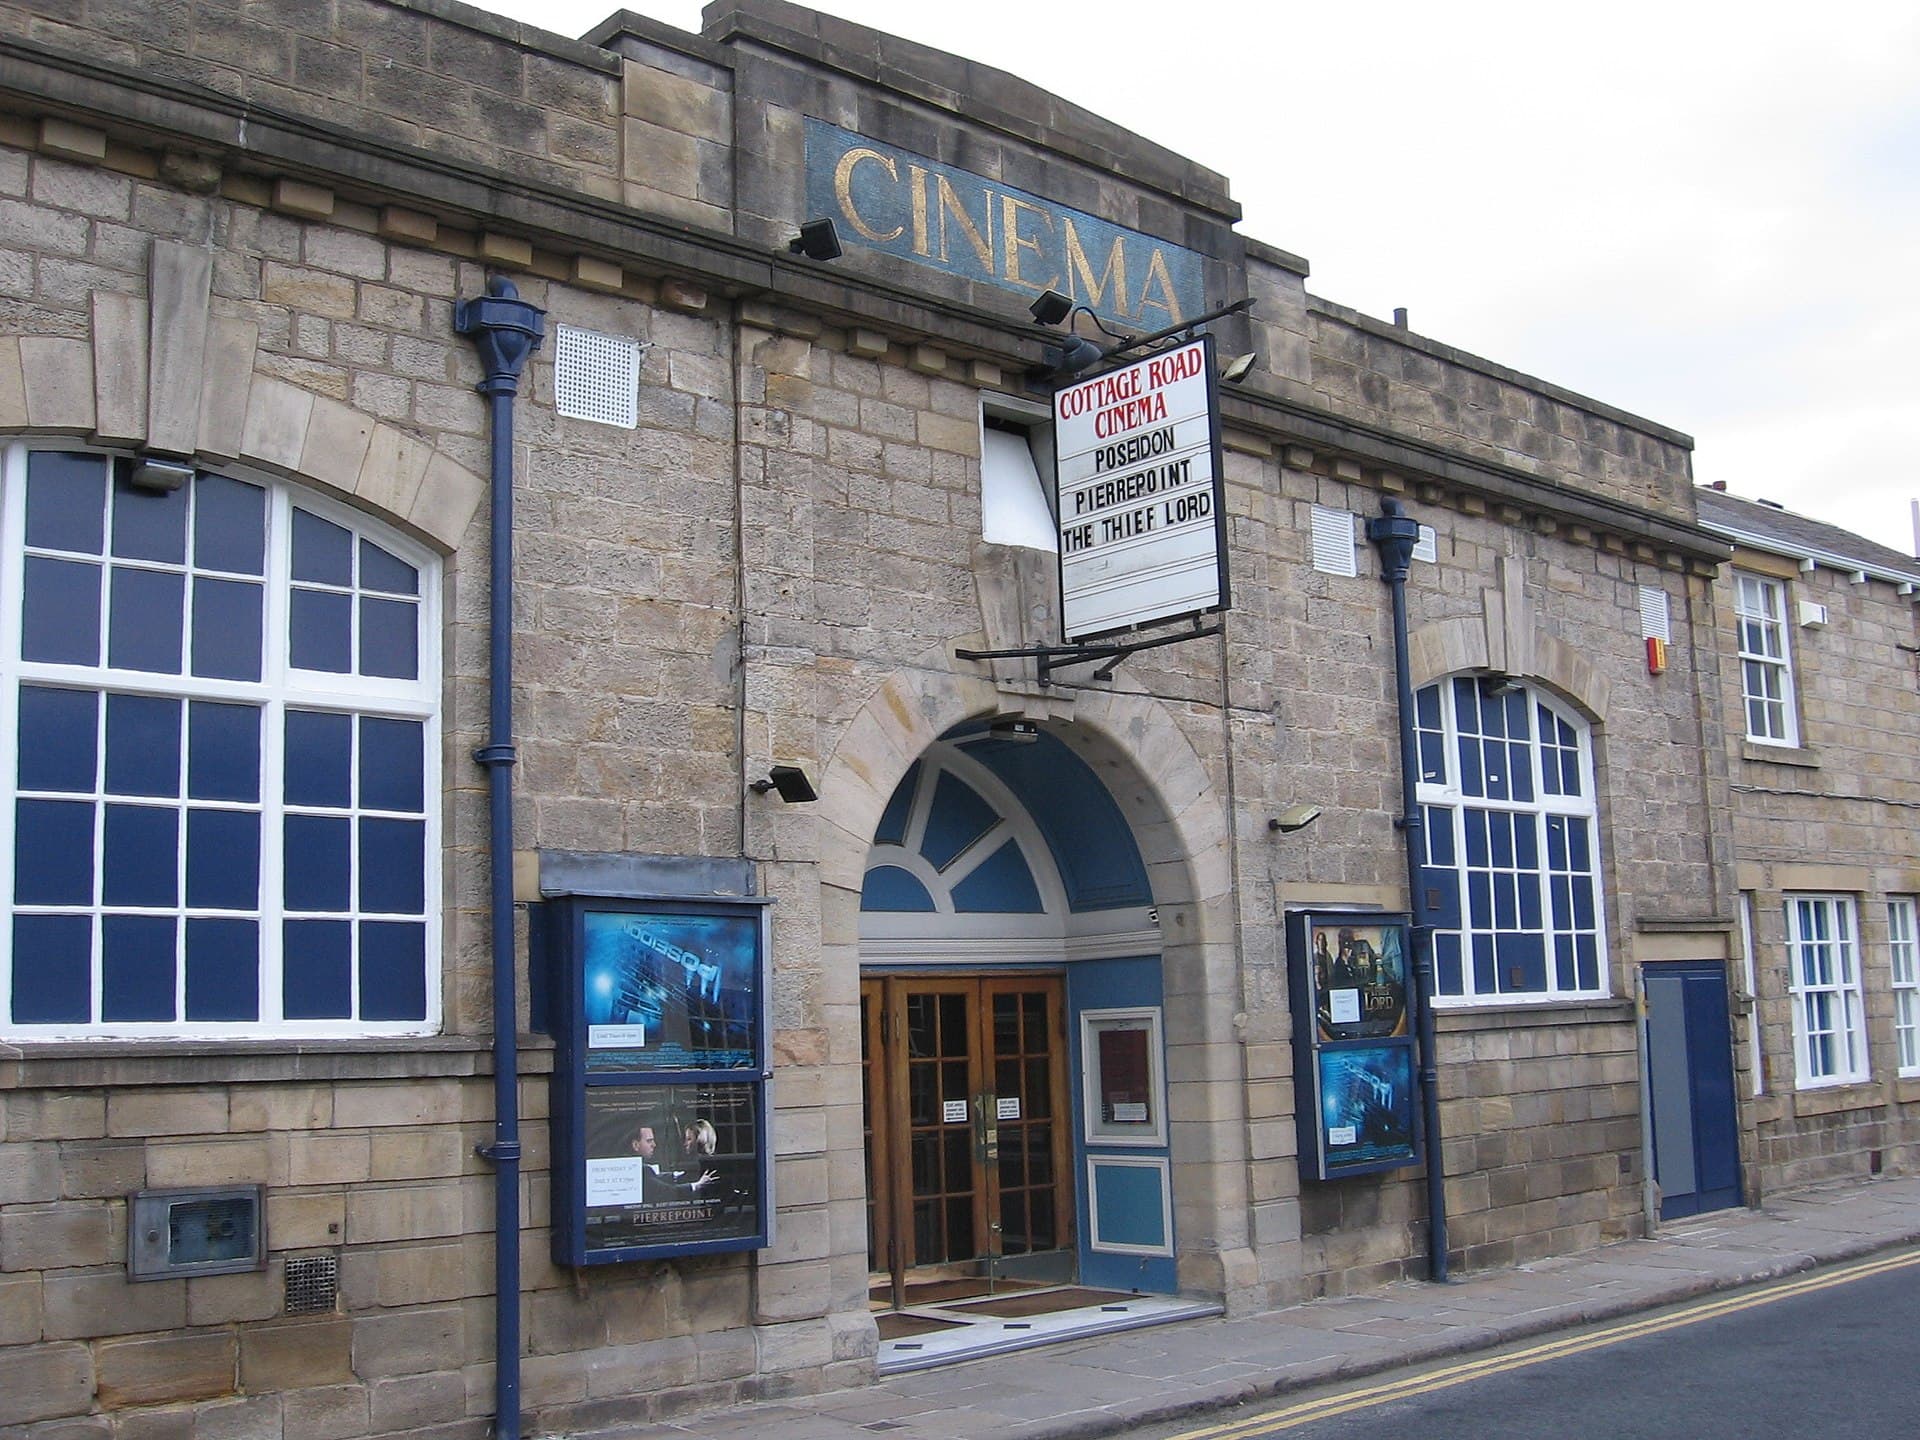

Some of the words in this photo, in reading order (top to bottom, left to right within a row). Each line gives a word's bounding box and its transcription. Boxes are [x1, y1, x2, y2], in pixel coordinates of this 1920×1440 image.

[833, 147, 1184, 325] CINEMA
[1059, 367, 1142, 421] COTTAGE
[1148, 347, 1203, 389] ROAD
[1094, 391, 1169, 440] CINEMA
[1095, 427, 1175, 473] POSEIDON
[1076, 459, 1191, 514] PIERREPOINT
[1062, 524, 1092, 553] THE
[1102, 507, 1155, 543] THIEF
[1166, 492, 1210, 525] LORD
[632, 1202, 714, 1224] PIERREPOINT
